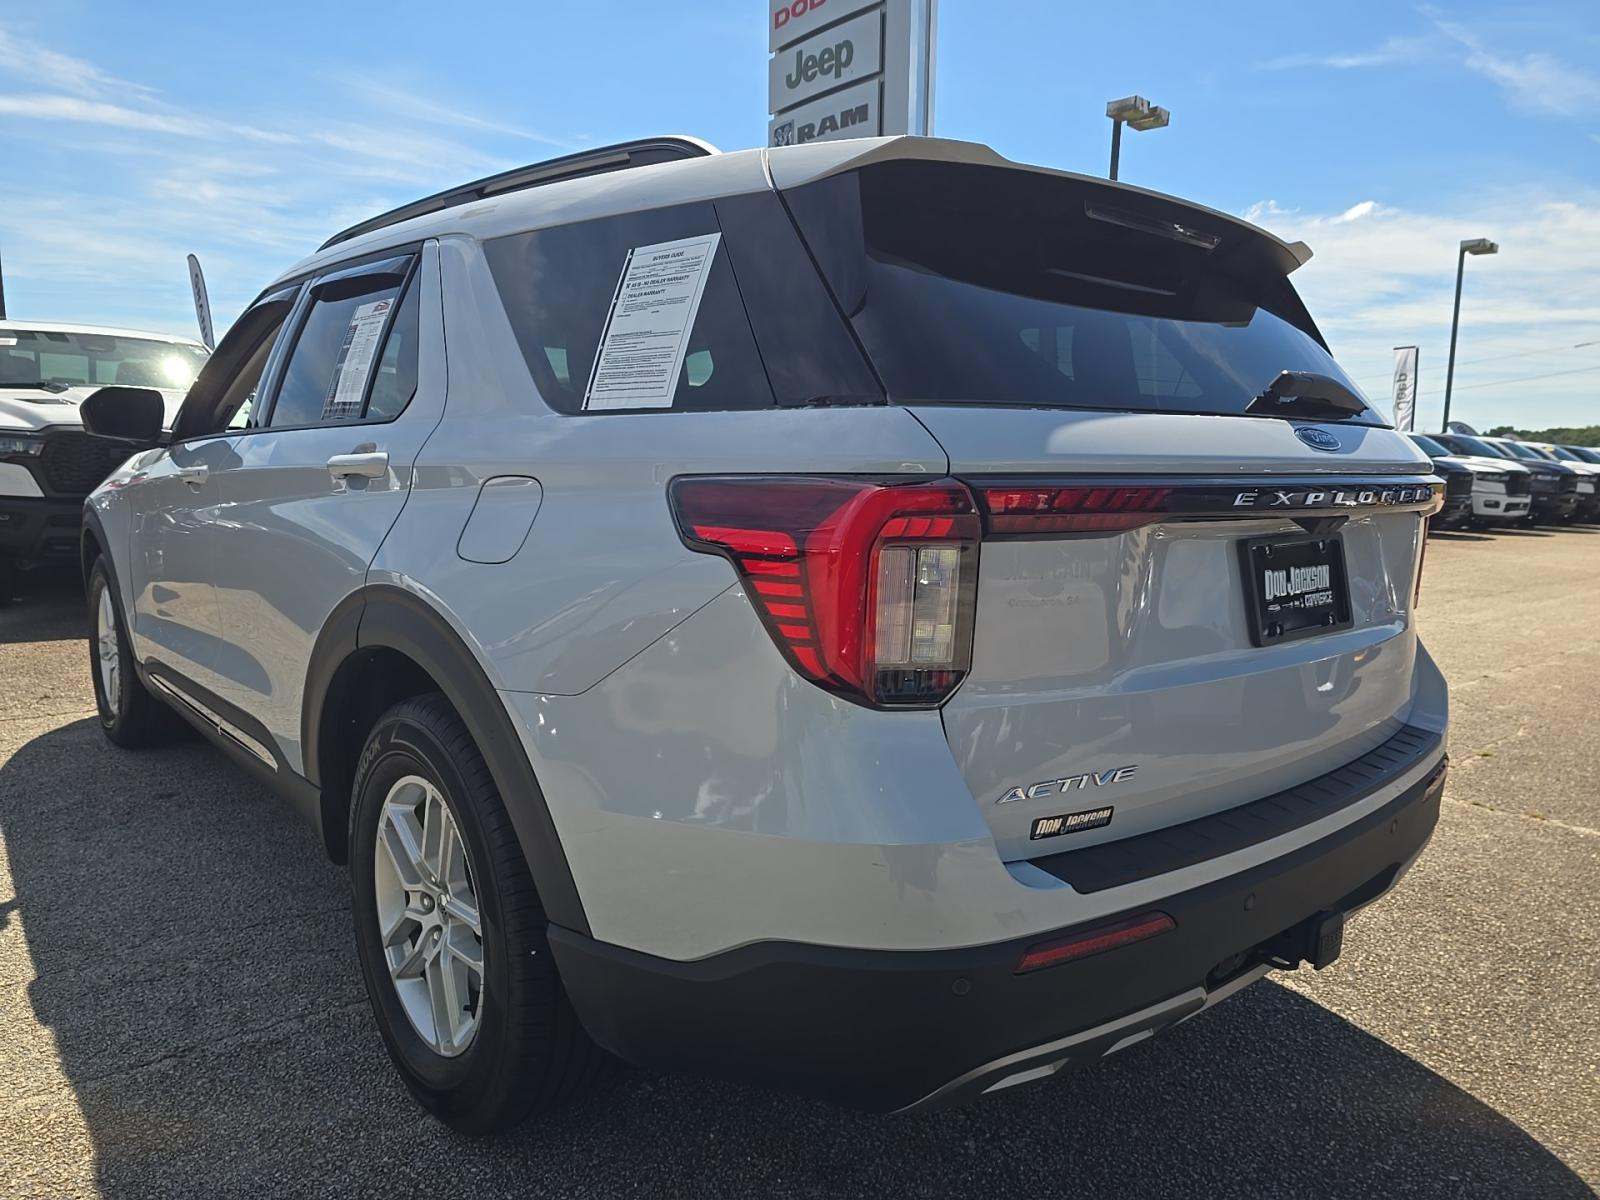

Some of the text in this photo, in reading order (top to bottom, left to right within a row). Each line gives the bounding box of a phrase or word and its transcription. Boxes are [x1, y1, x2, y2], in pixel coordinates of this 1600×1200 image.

[785, 39, 854, 90] Jeep
[797, 103, 868, 144] RAM
[995, 765, 1139, 804] ACTIVE
